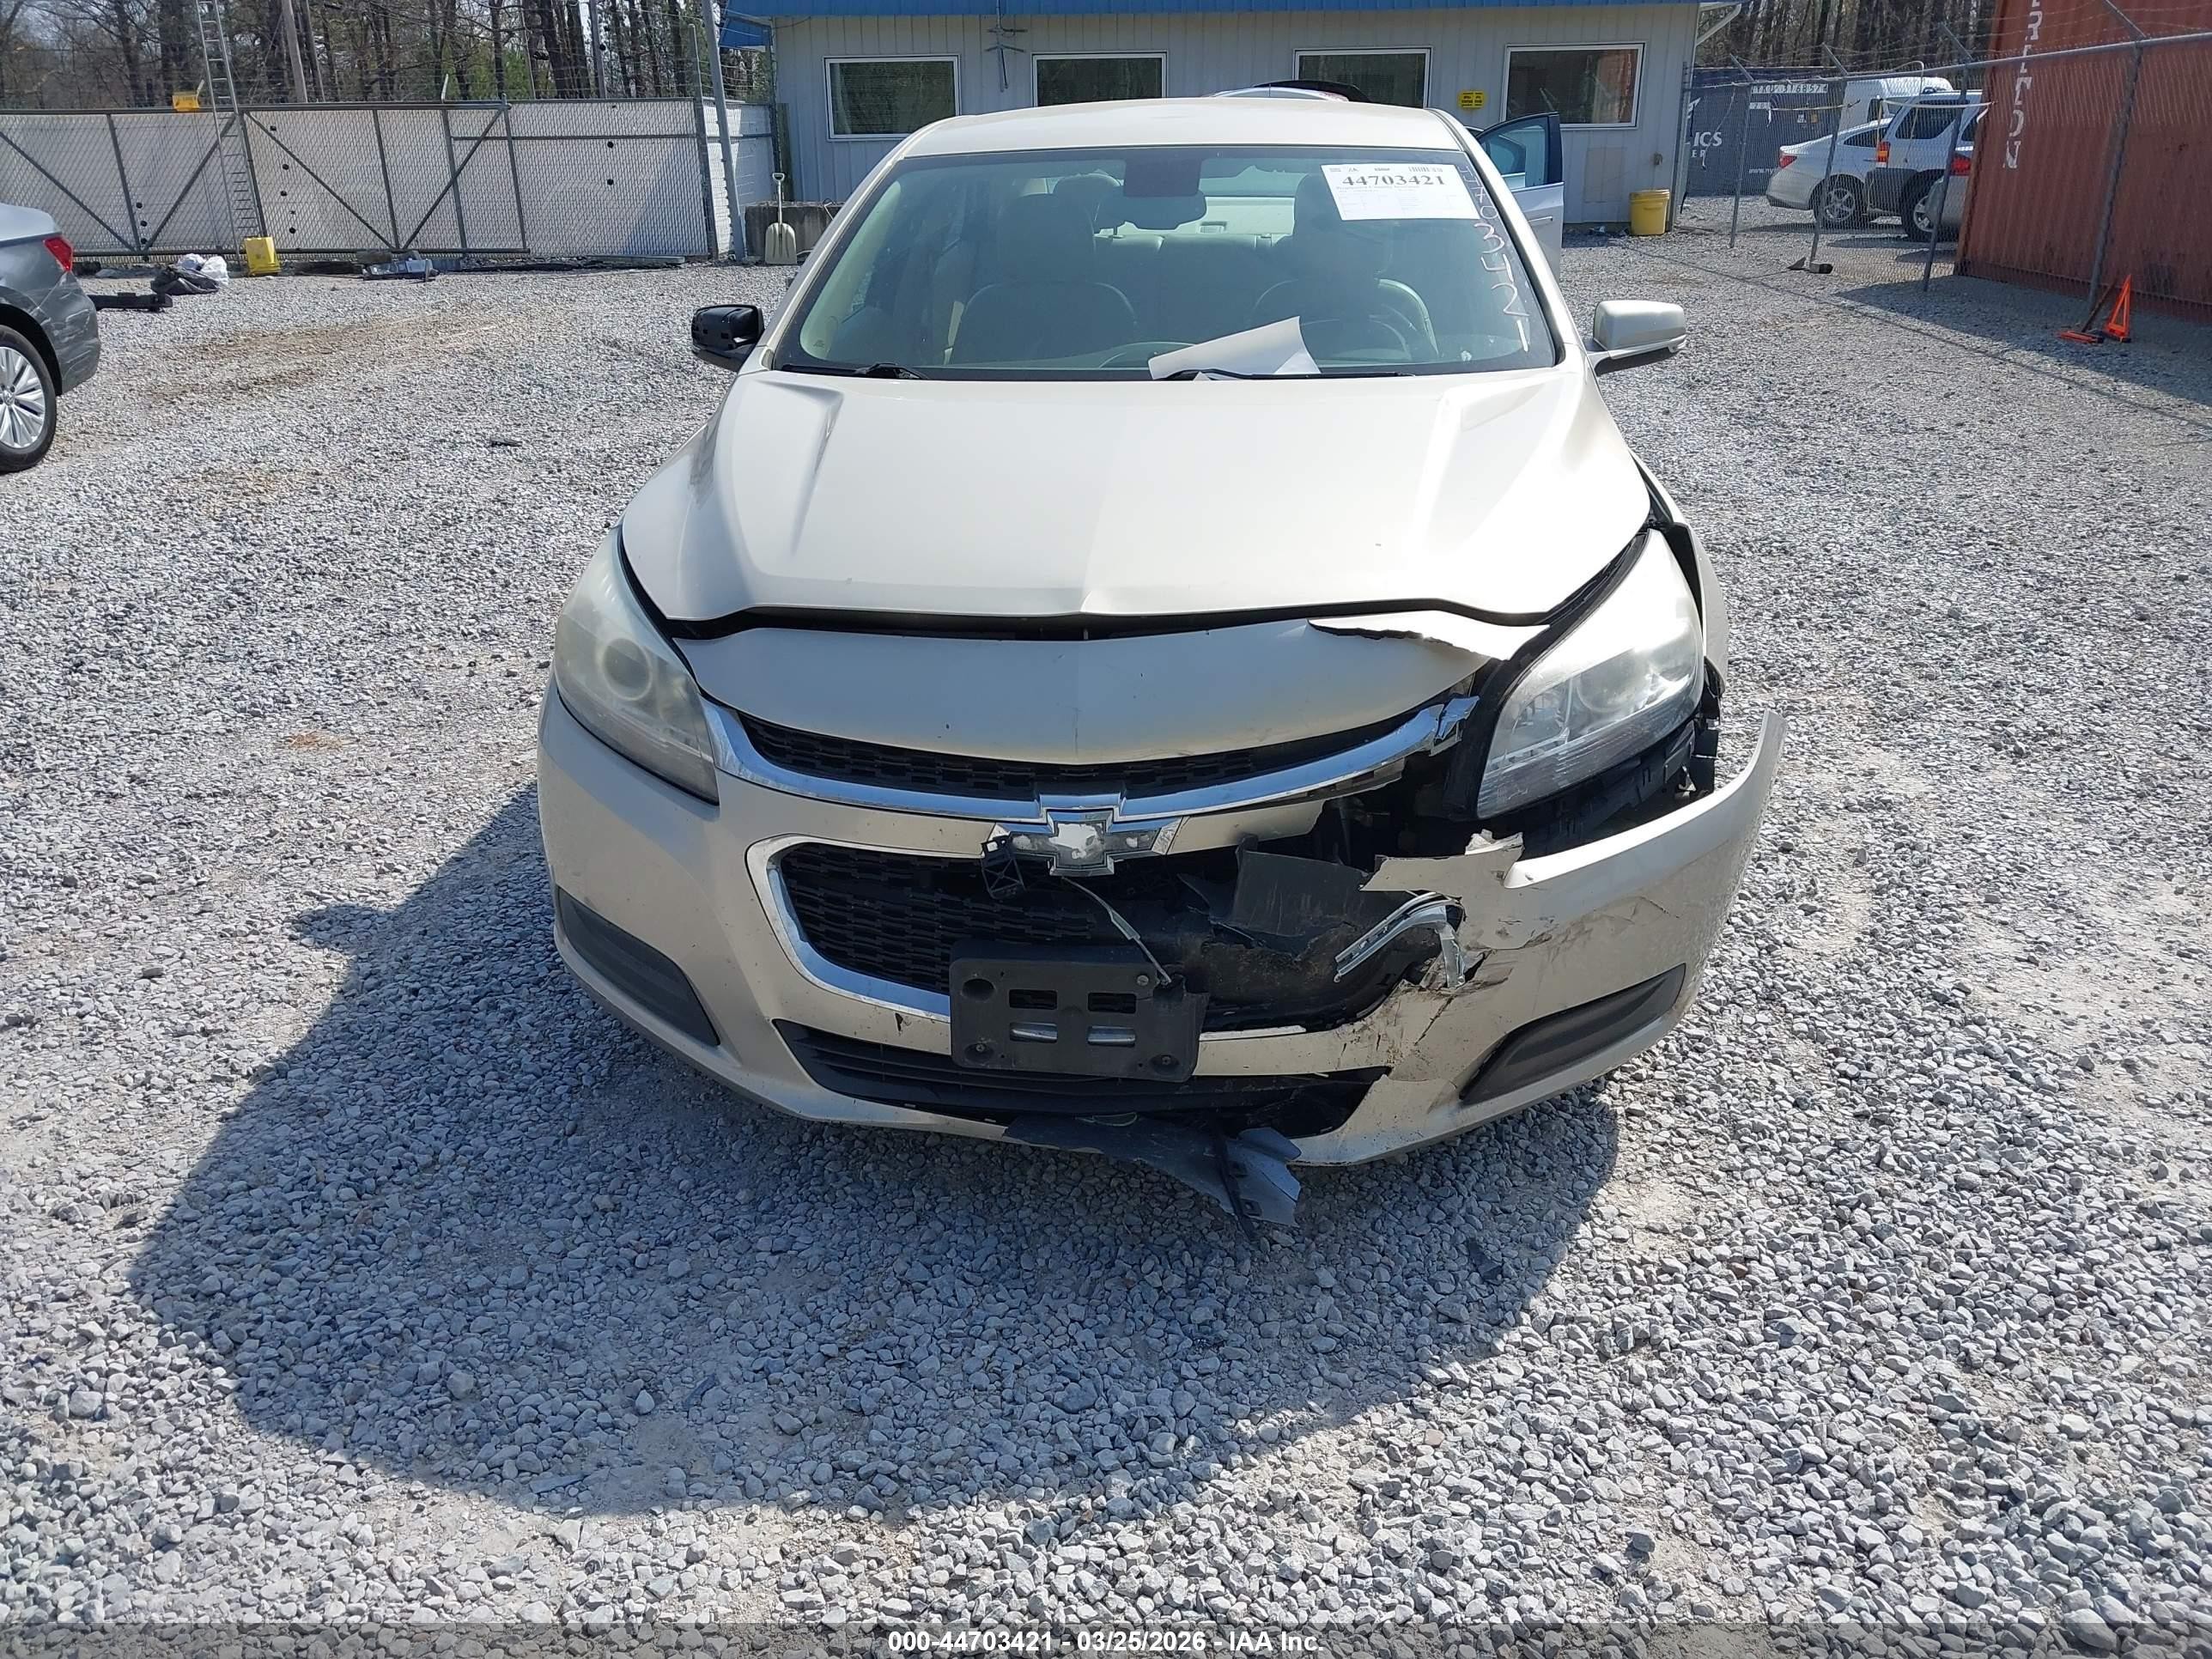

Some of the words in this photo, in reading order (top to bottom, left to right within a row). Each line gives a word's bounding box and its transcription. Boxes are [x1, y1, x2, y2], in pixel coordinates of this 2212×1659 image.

[2003, 0, 2044, 168] RITON
[1693, 131, 1723, 147] ICS
[1692, 149, 1705, 158] ER
[1342, 174, 1445, 185] 44703421
